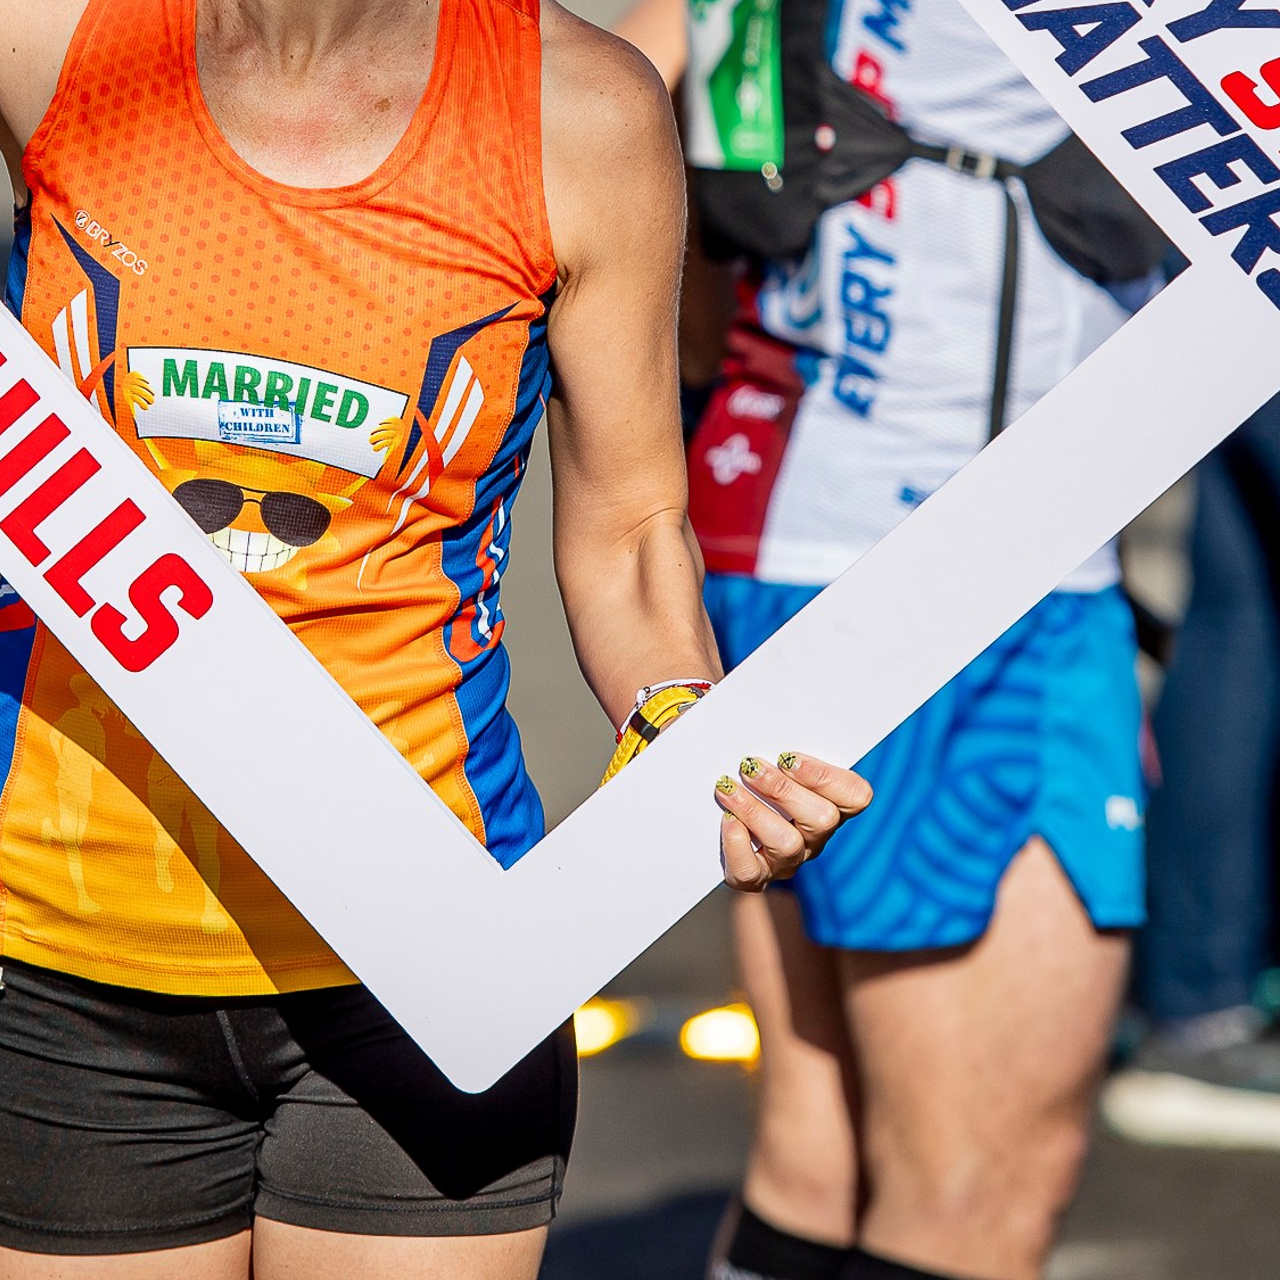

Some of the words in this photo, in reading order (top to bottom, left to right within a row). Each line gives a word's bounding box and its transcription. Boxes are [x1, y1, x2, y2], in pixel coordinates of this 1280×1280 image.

[832, 222, 897, 419] EVERY
[162, 358, 370, 430] MARRIED
[239, 406, 275, 419] WITH
[224, 420, 291, 434] CHILDREN
